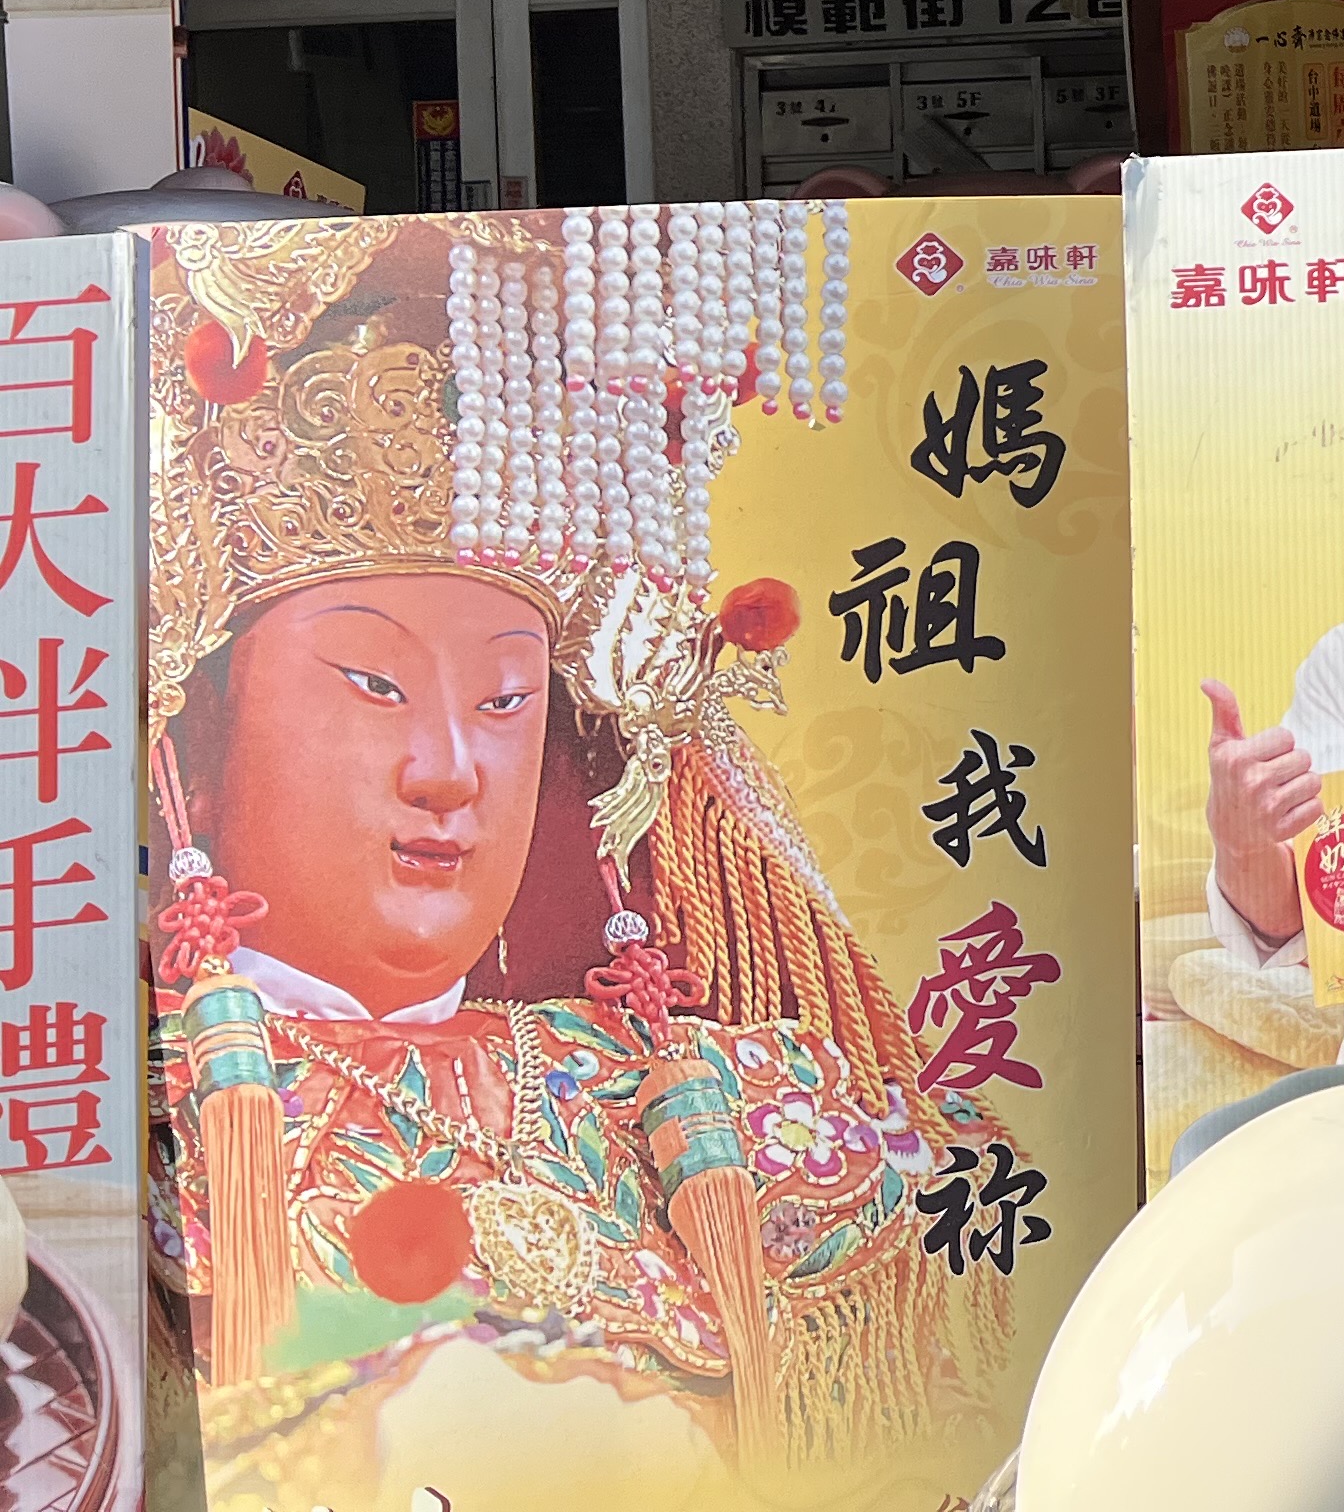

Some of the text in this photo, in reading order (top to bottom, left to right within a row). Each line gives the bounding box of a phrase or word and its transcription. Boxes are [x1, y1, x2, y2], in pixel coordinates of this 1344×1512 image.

[986, 244, 1099, 273] 嘉味軒
[829, 359, 1068, 1278] 媽祖我愛祢
